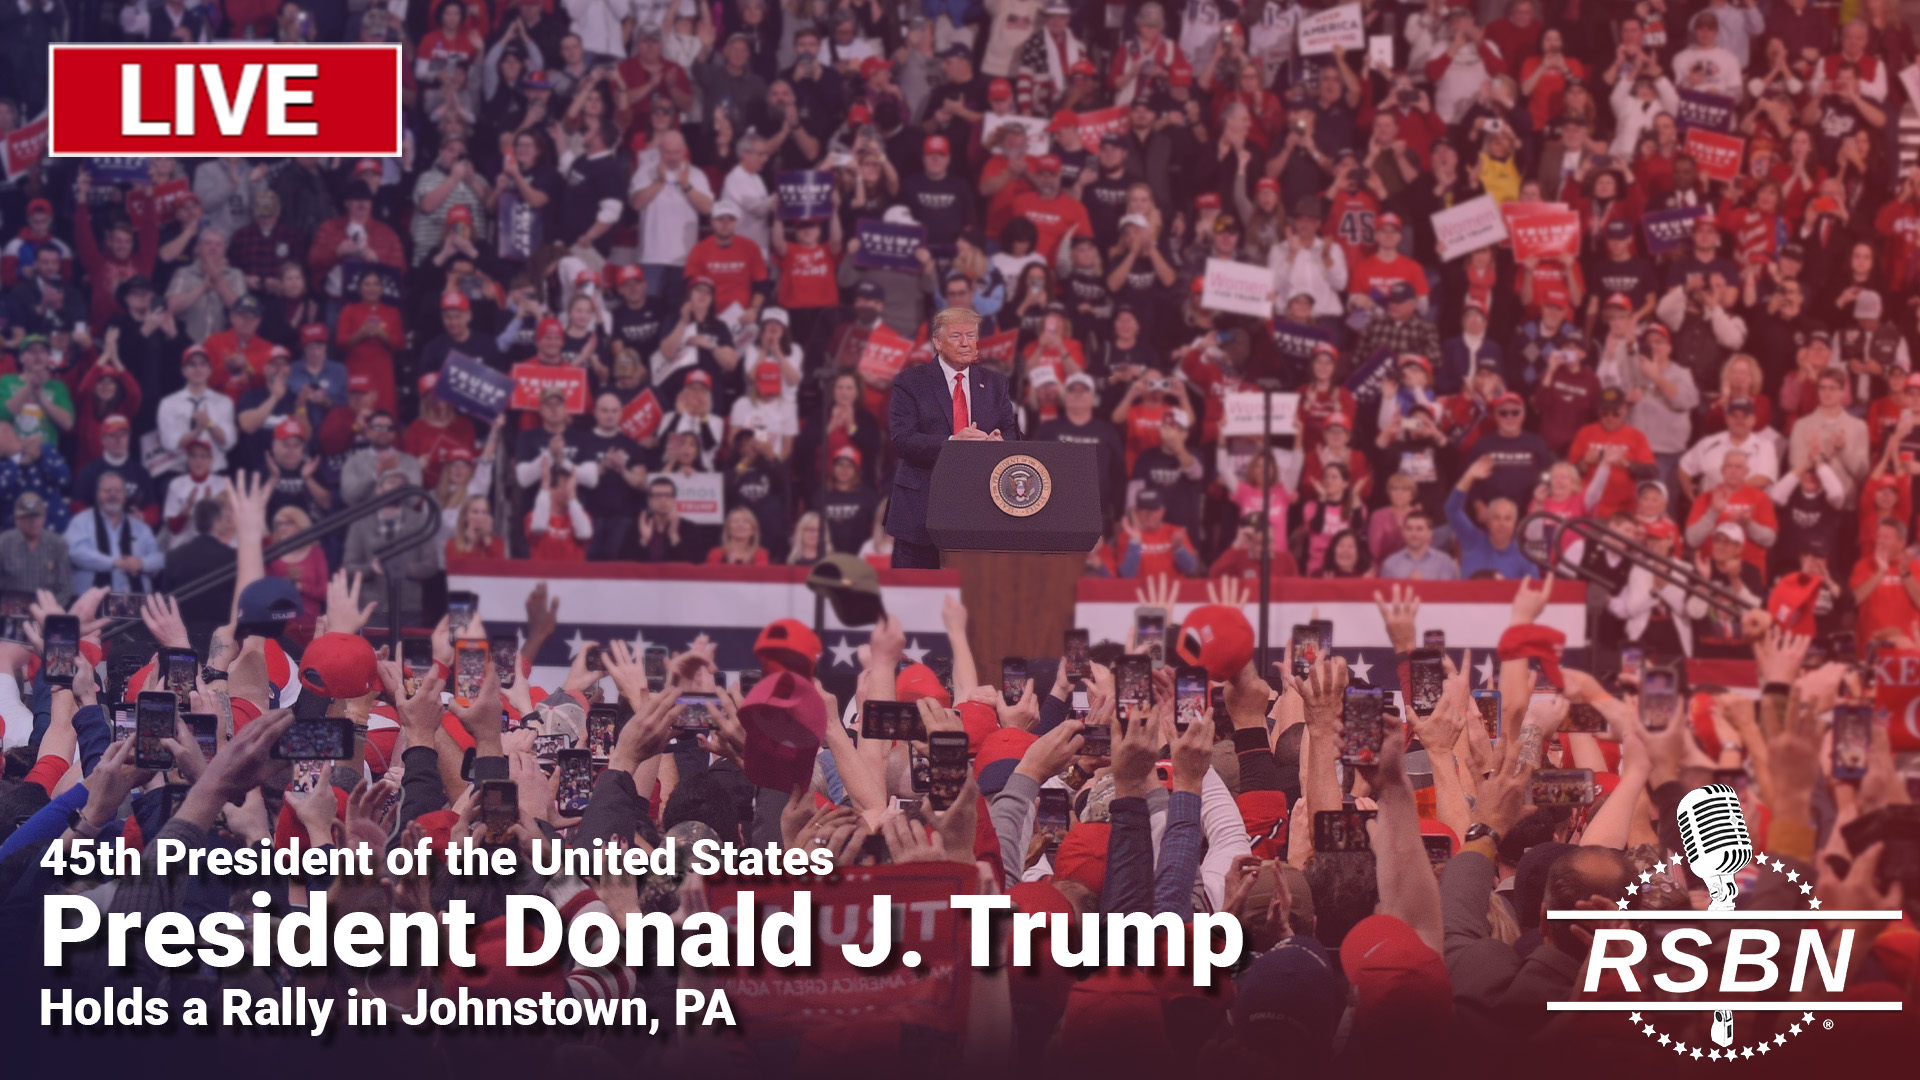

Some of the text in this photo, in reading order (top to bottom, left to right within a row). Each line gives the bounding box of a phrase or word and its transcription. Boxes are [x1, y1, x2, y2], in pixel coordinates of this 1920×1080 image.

[1302, 20, 1359, 38] AMERICA
[1681, 101, 1728, 116] TRUMP
[1689, 142, 1737, 158] TRUMP
[779, 183, 832, 194] TRUMP
[1337, 209, 1377, 244] 45
[1516, 223, 1570, 236] TRUMP
[1649, 217, 1694, 233] TRUM
[862, 232, 921, 247] TRUMP
[1210, 272, 1270, 295] Women
[1275, 331, 1317, 347] TRUM
[449, 365, 506, 397] TRUMP
[520, 376, 580, 390] TRUMP
